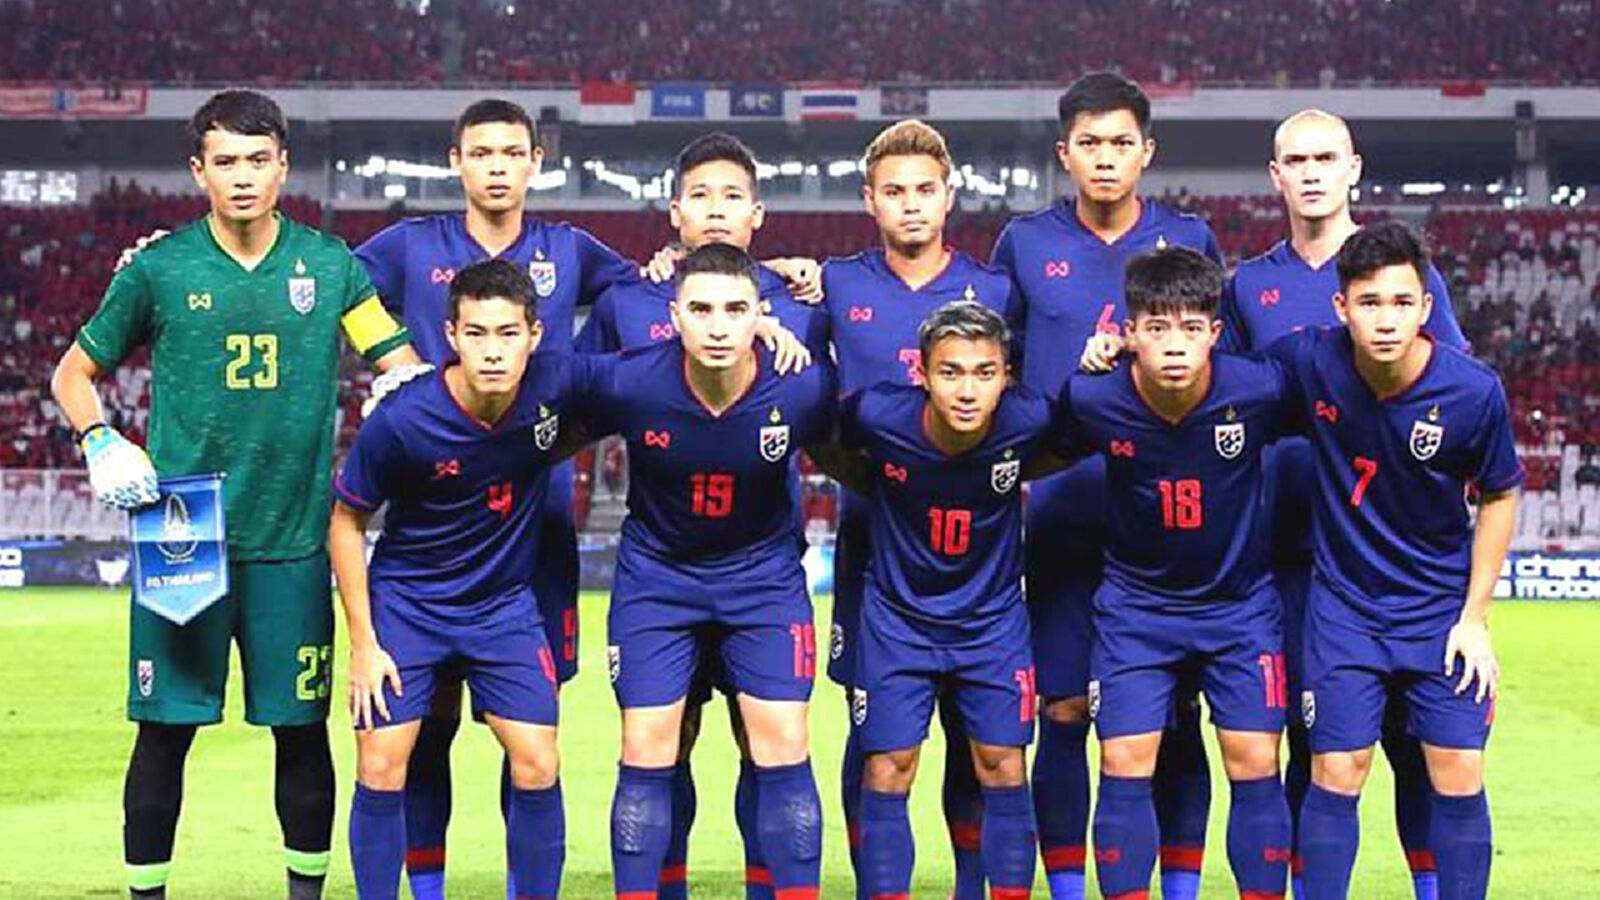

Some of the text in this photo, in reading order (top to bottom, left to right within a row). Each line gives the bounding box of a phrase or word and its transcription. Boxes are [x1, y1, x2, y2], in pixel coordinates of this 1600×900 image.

[226, 334, 278, 390] 23
[488, 480, 513, 519] 4
[691, 473, 734, 518] 19
[1158, 479, 1202, 530] 18
[1351, 454, 1377, 507] 7
[928, 506, 972, 556] 10
